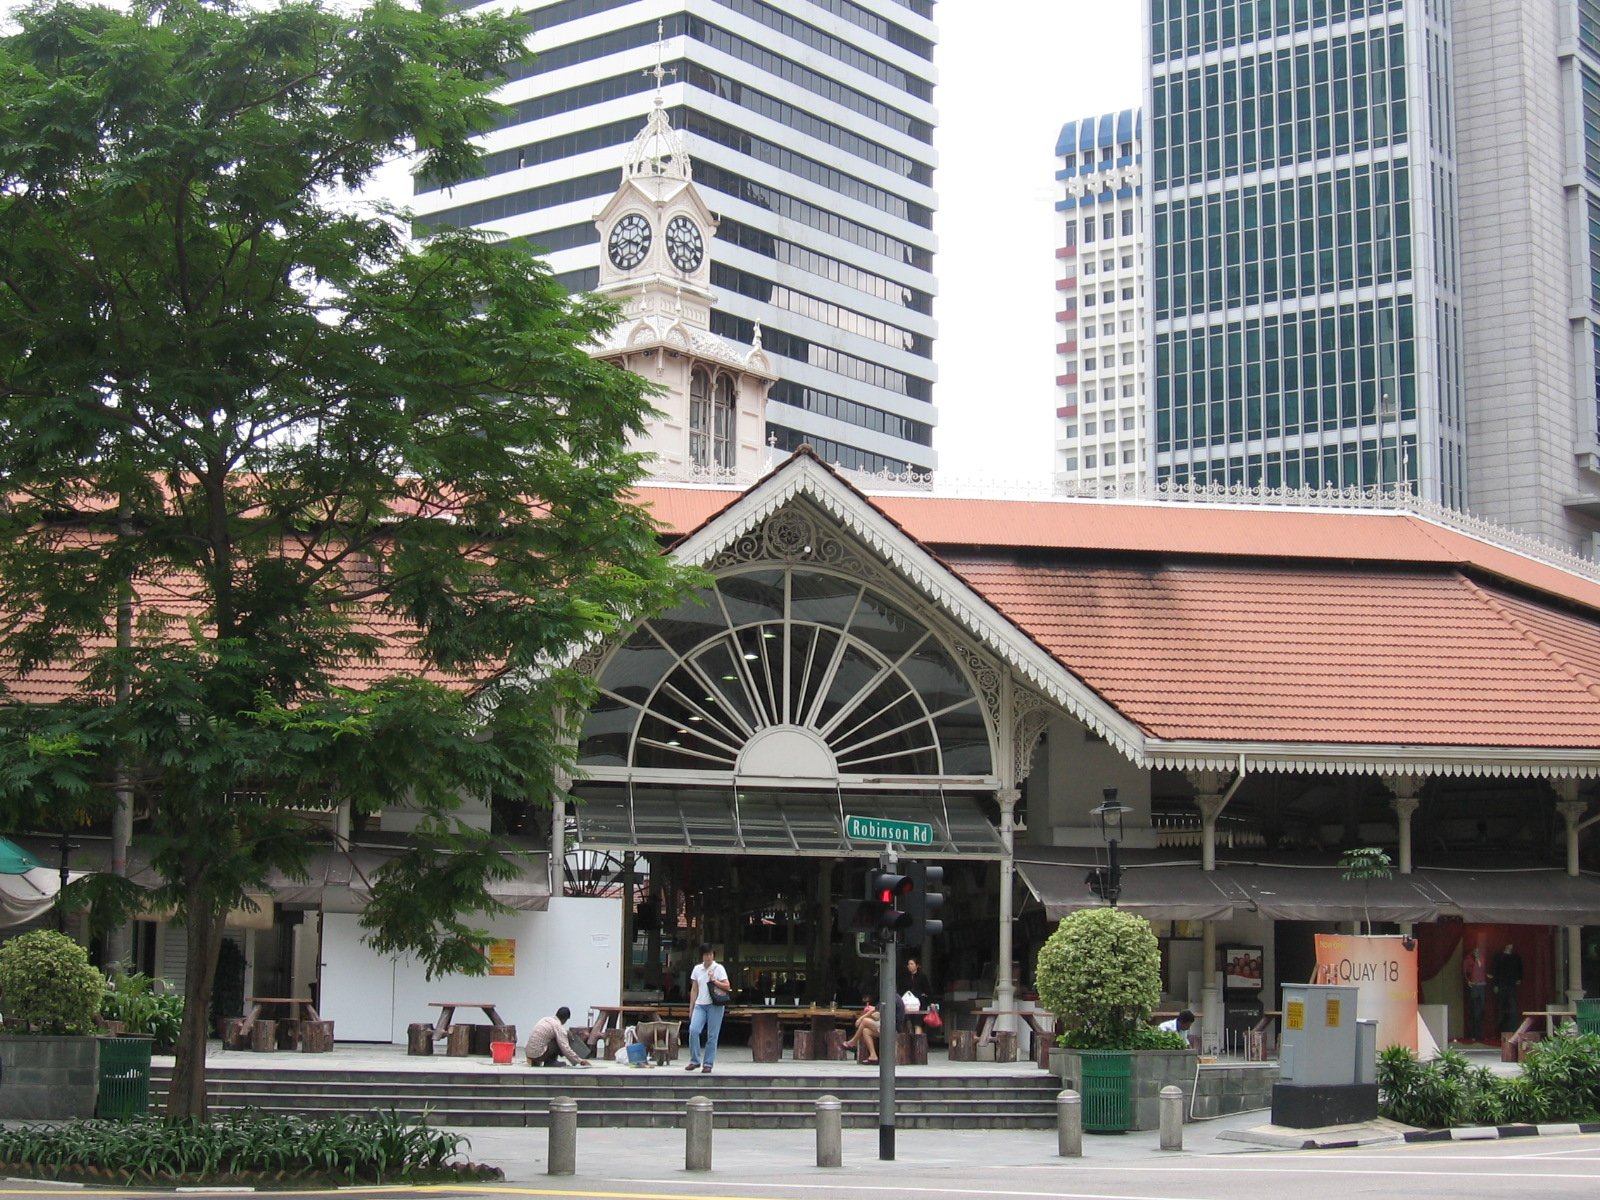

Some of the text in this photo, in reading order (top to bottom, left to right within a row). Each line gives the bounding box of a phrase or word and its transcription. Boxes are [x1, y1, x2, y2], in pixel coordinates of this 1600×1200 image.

[853, 819, 927, 842] Robinson Rd
[1339, 958, 1399, 982] QUAY 18
